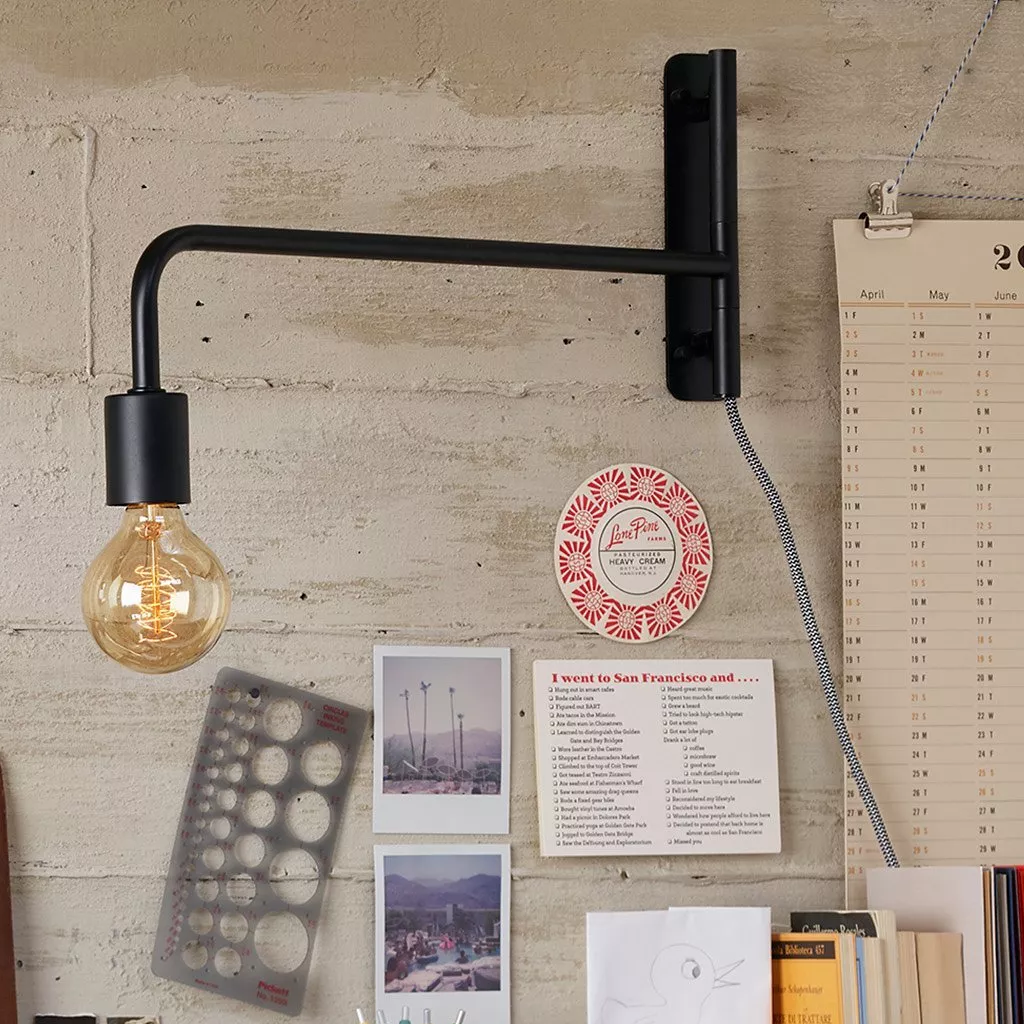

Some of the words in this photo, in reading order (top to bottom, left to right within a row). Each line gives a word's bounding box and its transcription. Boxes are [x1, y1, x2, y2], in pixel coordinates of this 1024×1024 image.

[860, 290, 884, 300] April
[929, 291, 949, 302] May
[995, 291, 1017, 300] June
[605, 524, 633, 550] Lone
[630, 517, 659, 539] Pine
[552, 674, 557, 683] I
[562, 674, 594, 683] went
[598, 674, 611, 683] to
[614, 673, 639, 683] San
[642, 673, 707, 683] Francisco
[710, 673, 734, 682] and
